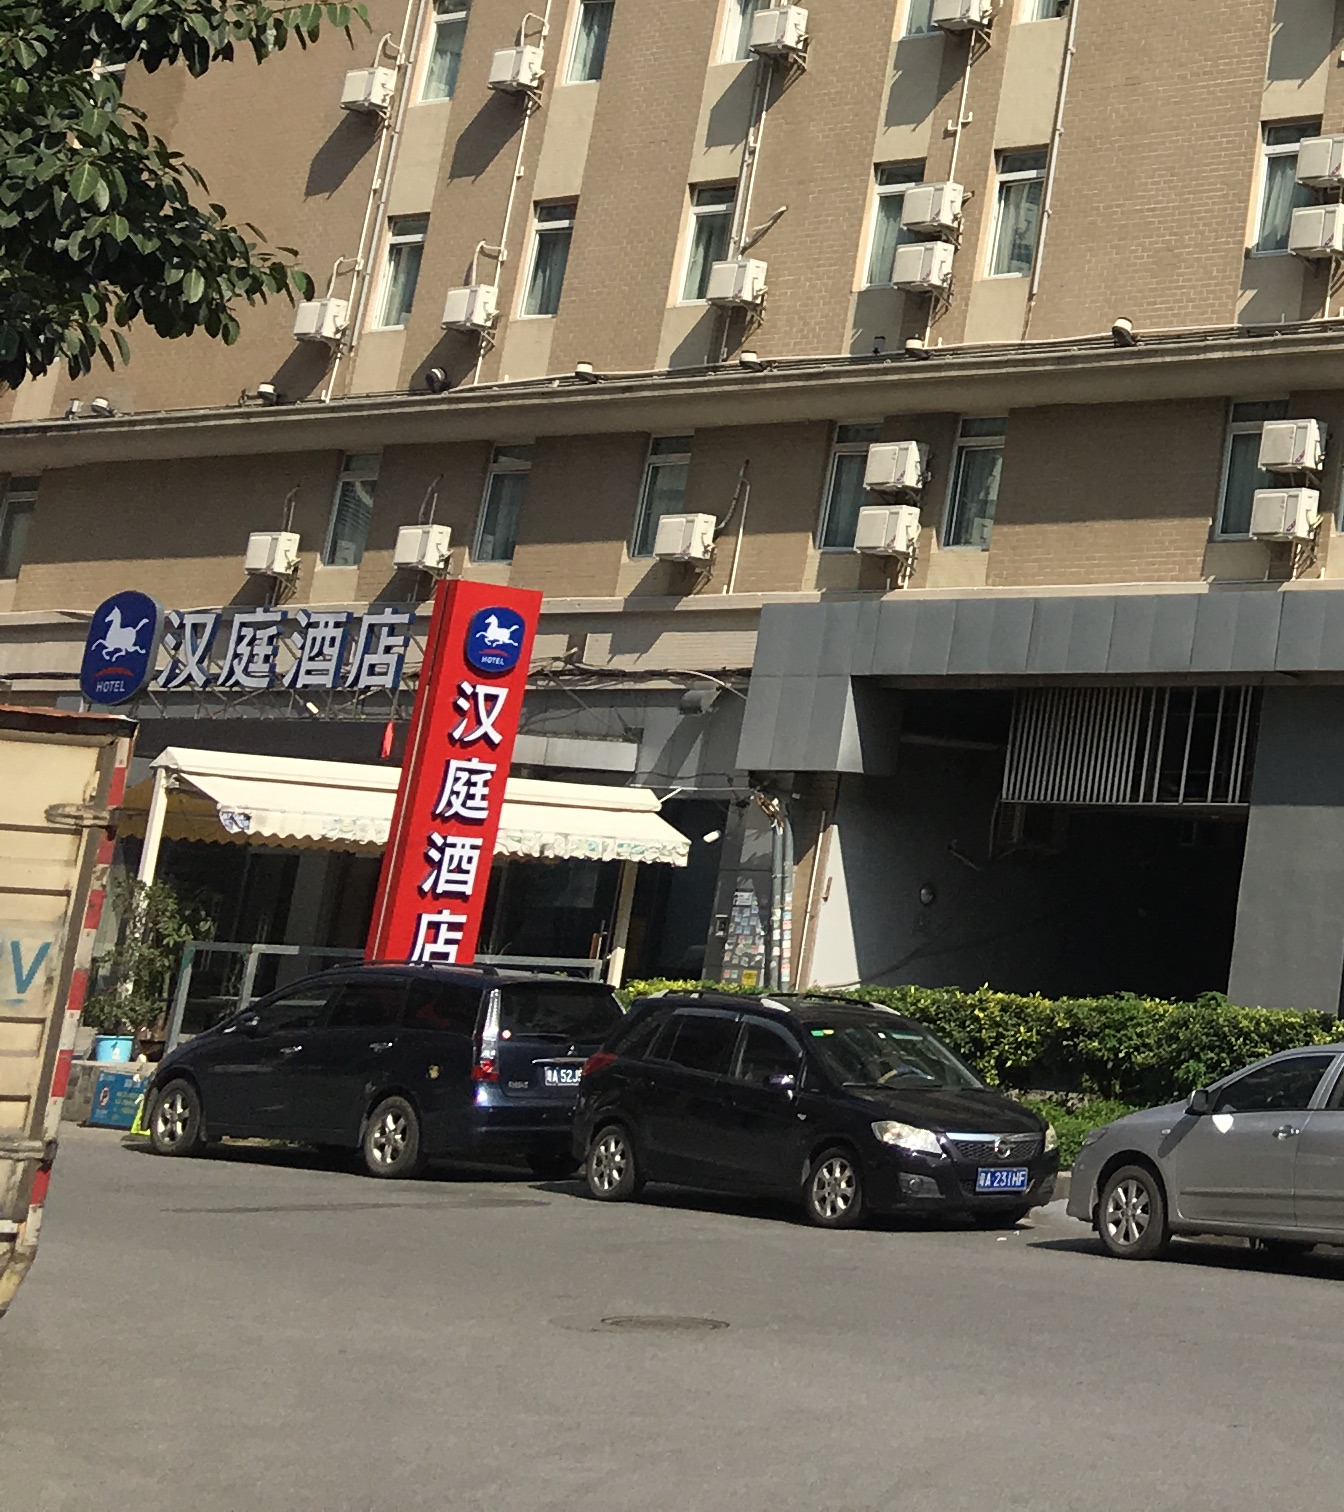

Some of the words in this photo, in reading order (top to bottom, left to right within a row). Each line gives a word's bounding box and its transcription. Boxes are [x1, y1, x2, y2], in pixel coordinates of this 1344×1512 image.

[157, 608, 413, 688] 汉庭酒店
[481, 656, 504, 665] HOTEL
[96, 680, 125, 693] HOTEL
[410, 680, 507, 965] 汉庭酒店
